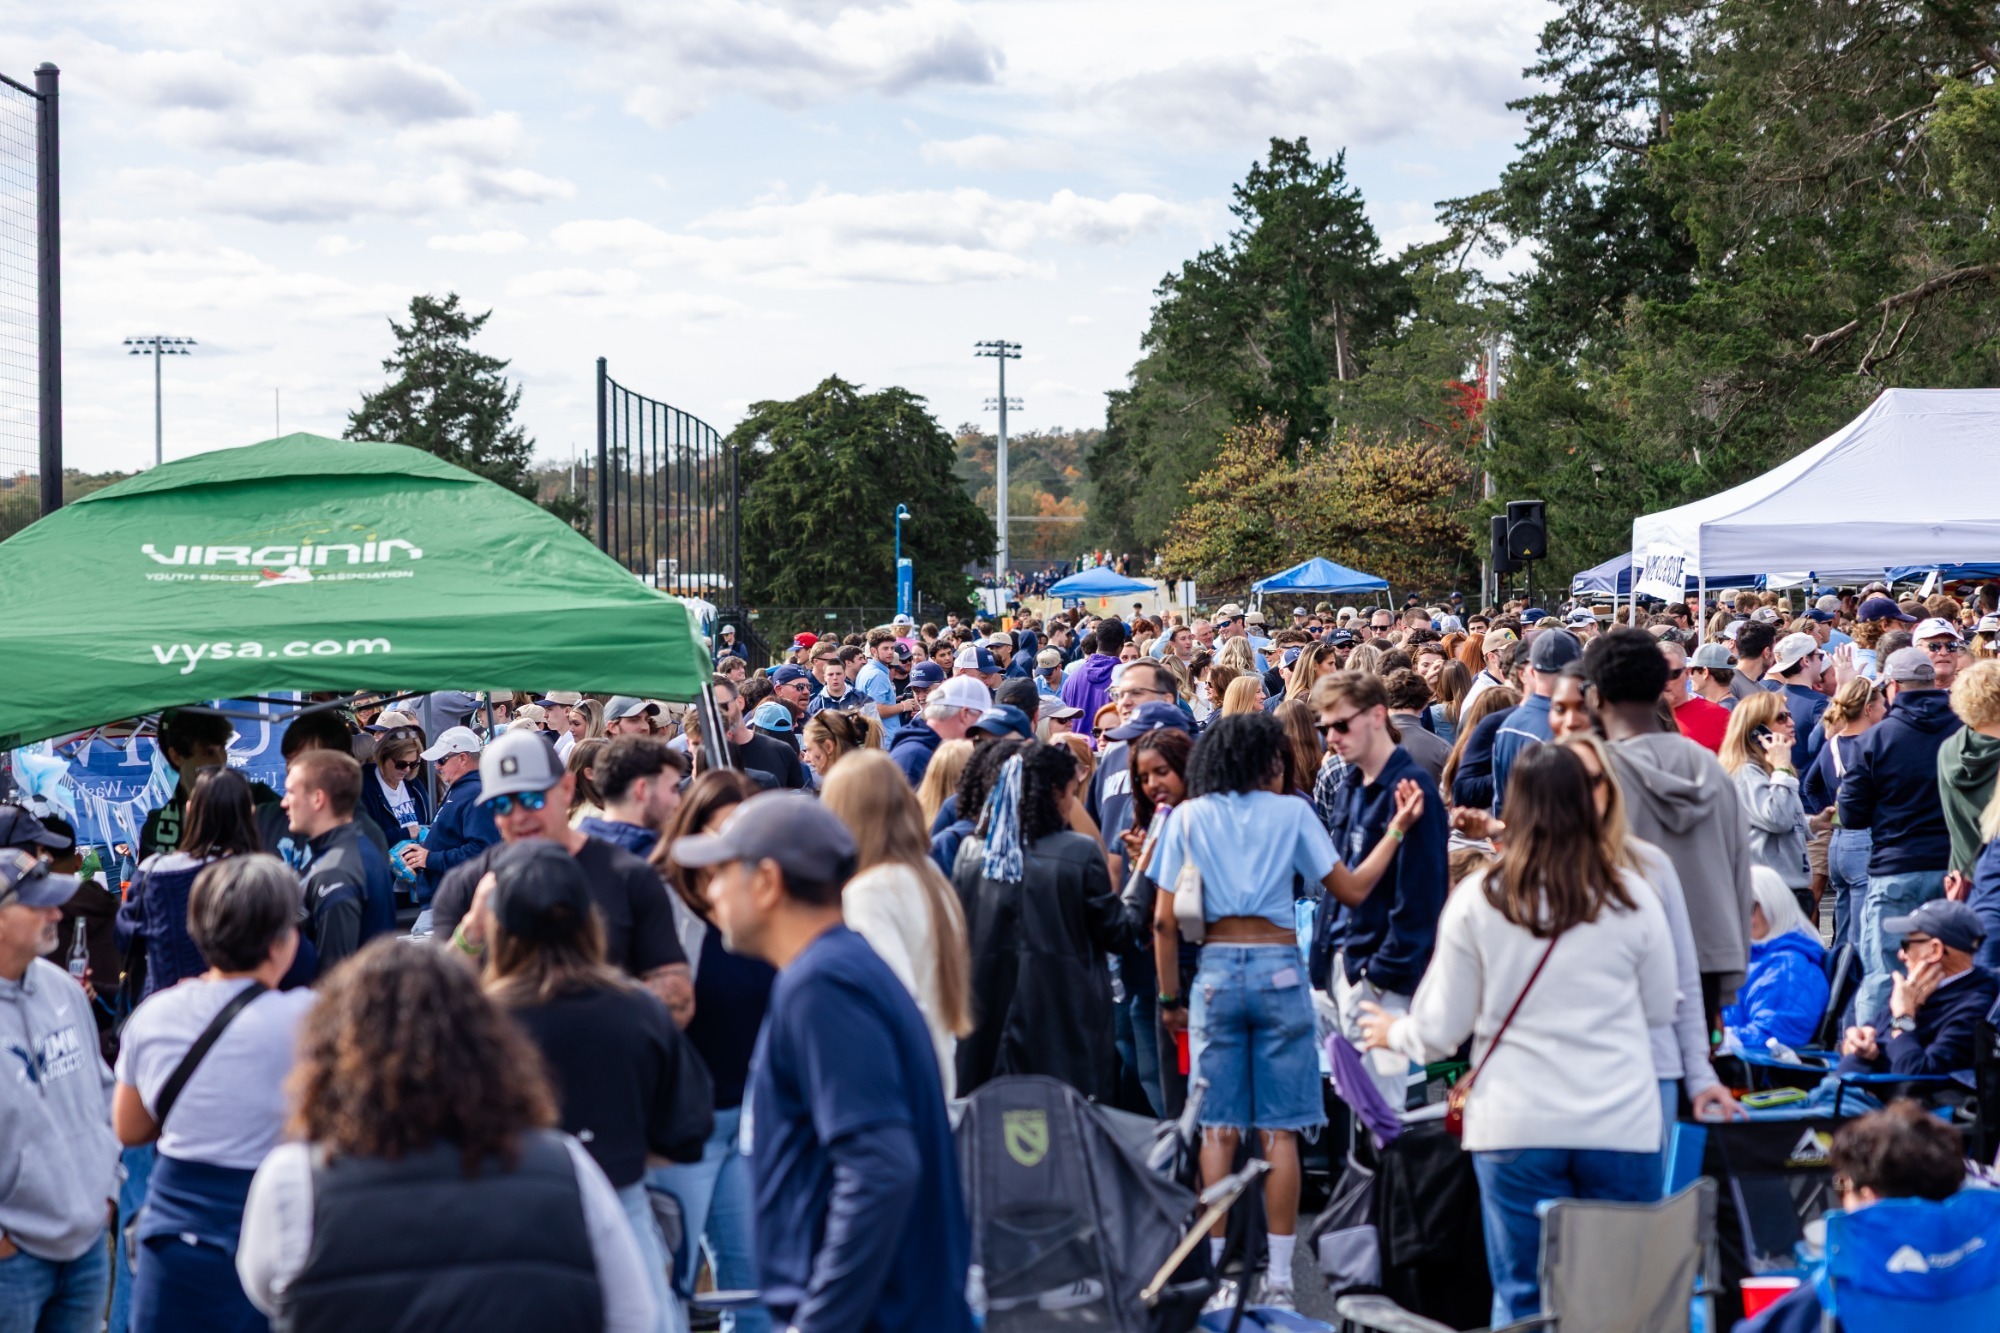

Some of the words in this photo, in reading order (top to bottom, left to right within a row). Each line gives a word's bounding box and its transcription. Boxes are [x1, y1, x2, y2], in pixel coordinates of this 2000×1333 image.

[146, 573, 195, 582] YOUTH
[200, 573, 261, 582] SOCCER
[317, 569, 414, 582] ASSOCIATION
[152, 638, 391, 675] vysa.com
